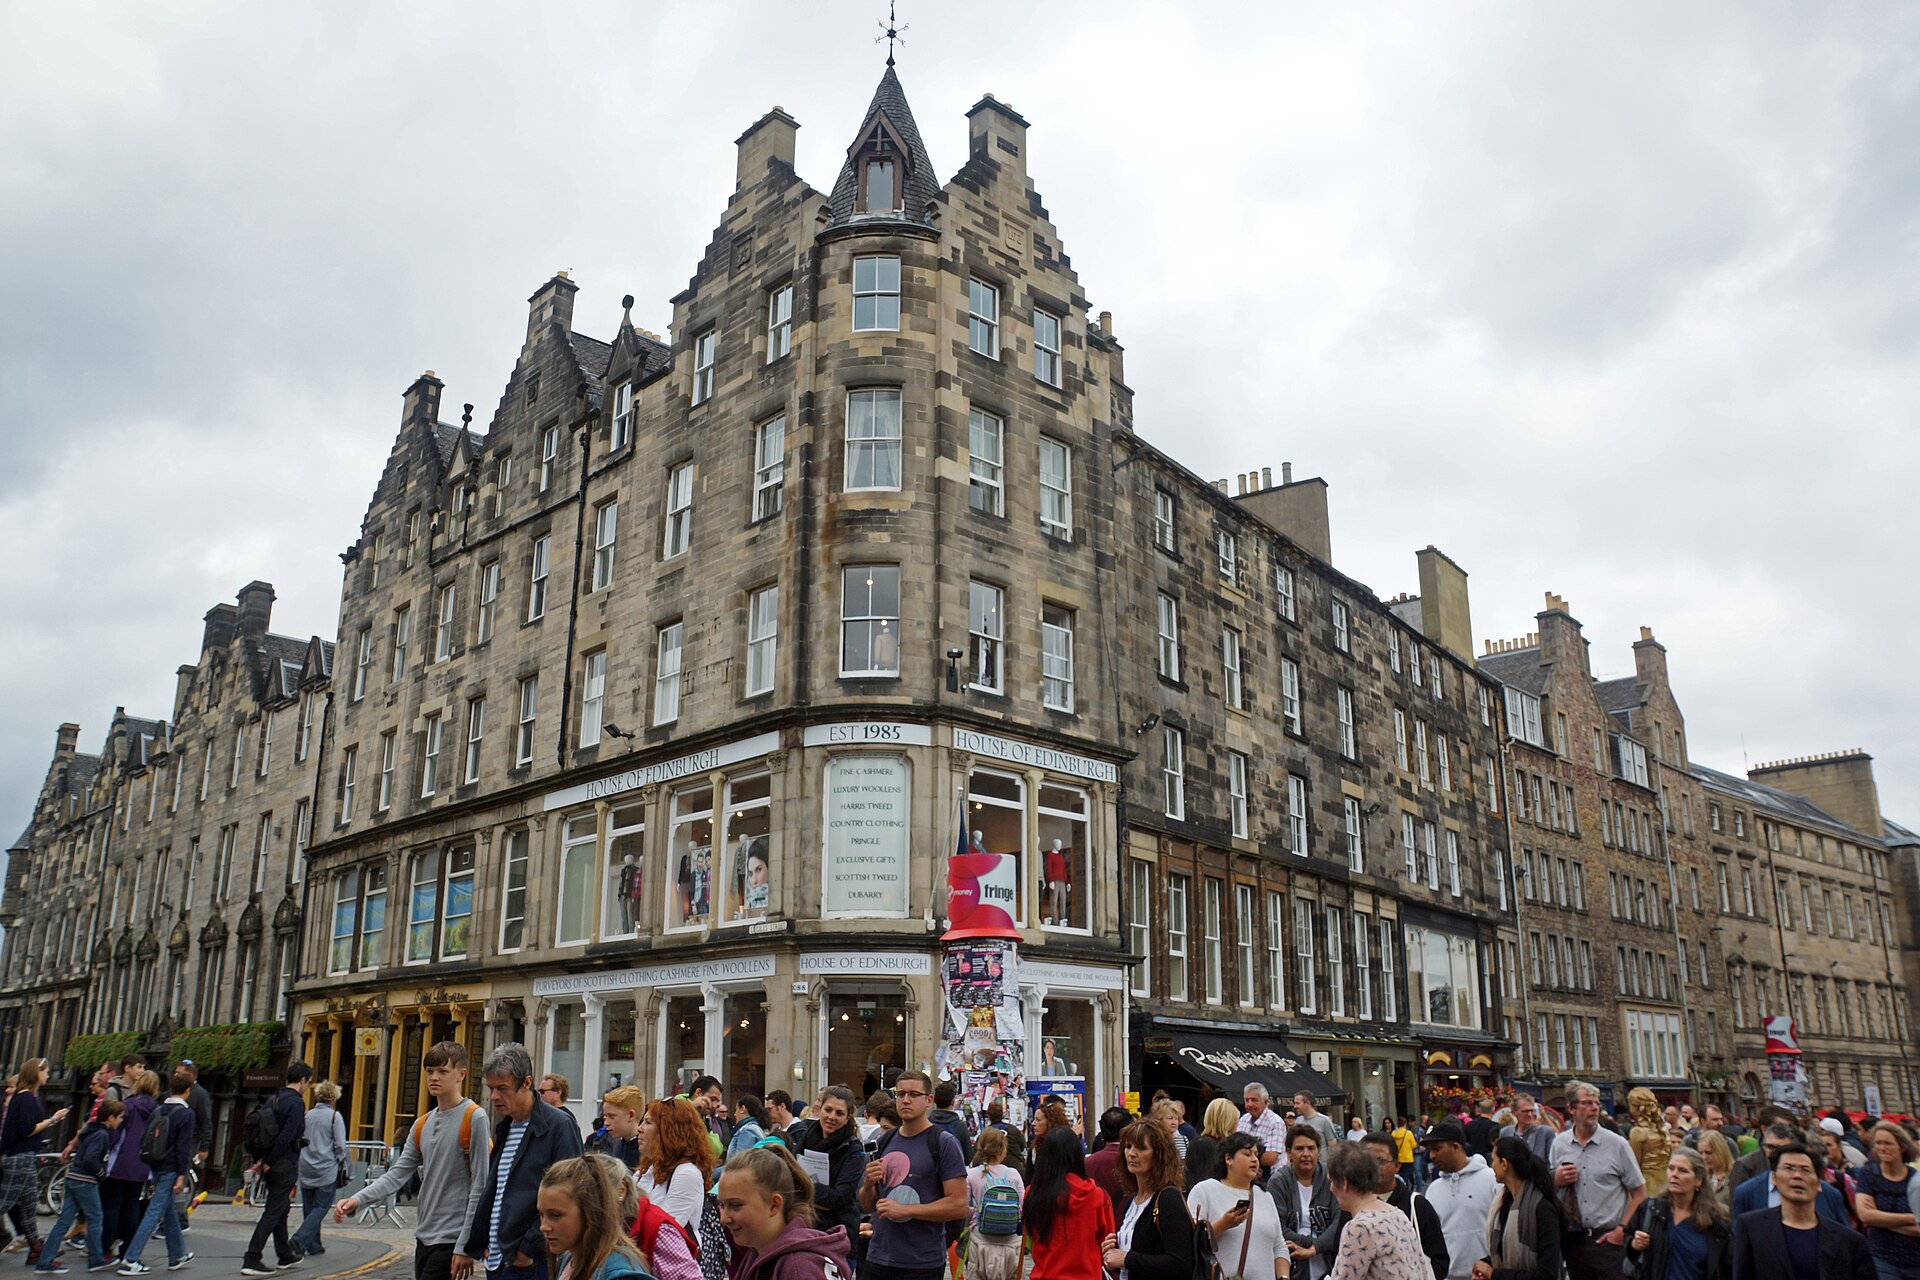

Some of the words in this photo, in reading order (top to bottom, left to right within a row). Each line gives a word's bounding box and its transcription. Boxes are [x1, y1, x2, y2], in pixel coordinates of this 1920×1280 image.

[829, 725, 859, 741] EST
[864, 724, 902, 740] 1985
[956, 731, 1008, 757] HOUSE
[1012, 744, 1032, 761] OF
[1035, 746, 1114, 781] EDINBURGH
[586, 774, 623, 800] HOUSE
[626, 769, 643, 788] OF
[645, 748, 720, 784] EDINBURGH
[839, 768, 855, 776] FINE
[856, 768, 894, 776] CASHMERE
[833, 785, 860, 794] LUXURY
[861, 785, 901, 794] WOOLLENS
[868, 802, 893, 810] TWEED
[830, 820, 863, 828] COUNTRY
[865, 820, 904, 828] CLOTHING
[851, 837, 880, 845] PRINGLE
[836, 856, 874, 864] EXCLUSIVE
[876, 856, 896, 864] GIFTS
[848, 891, 883, 899] DUBARRY
[954, 889, 974, 897] money
[984, 884, 1014, 902] fringe
[801, 957, 835, 969] HOUSE
[839, 957, 856, 968] OF
[859, 957, 928, 970] EDINBURGH
[535, 977, 572, 992] PURVEYORS
[573, 977, 582, 988] OF
[583, 974, 618, 988] SCOTTISH
[619, 970, 658, 984] CLOTHING
[660, 966, 701, 981] CASHMERE
[702, 963, 720, 977] FINE
[722, 959, 770, 974] WOOLLENS
